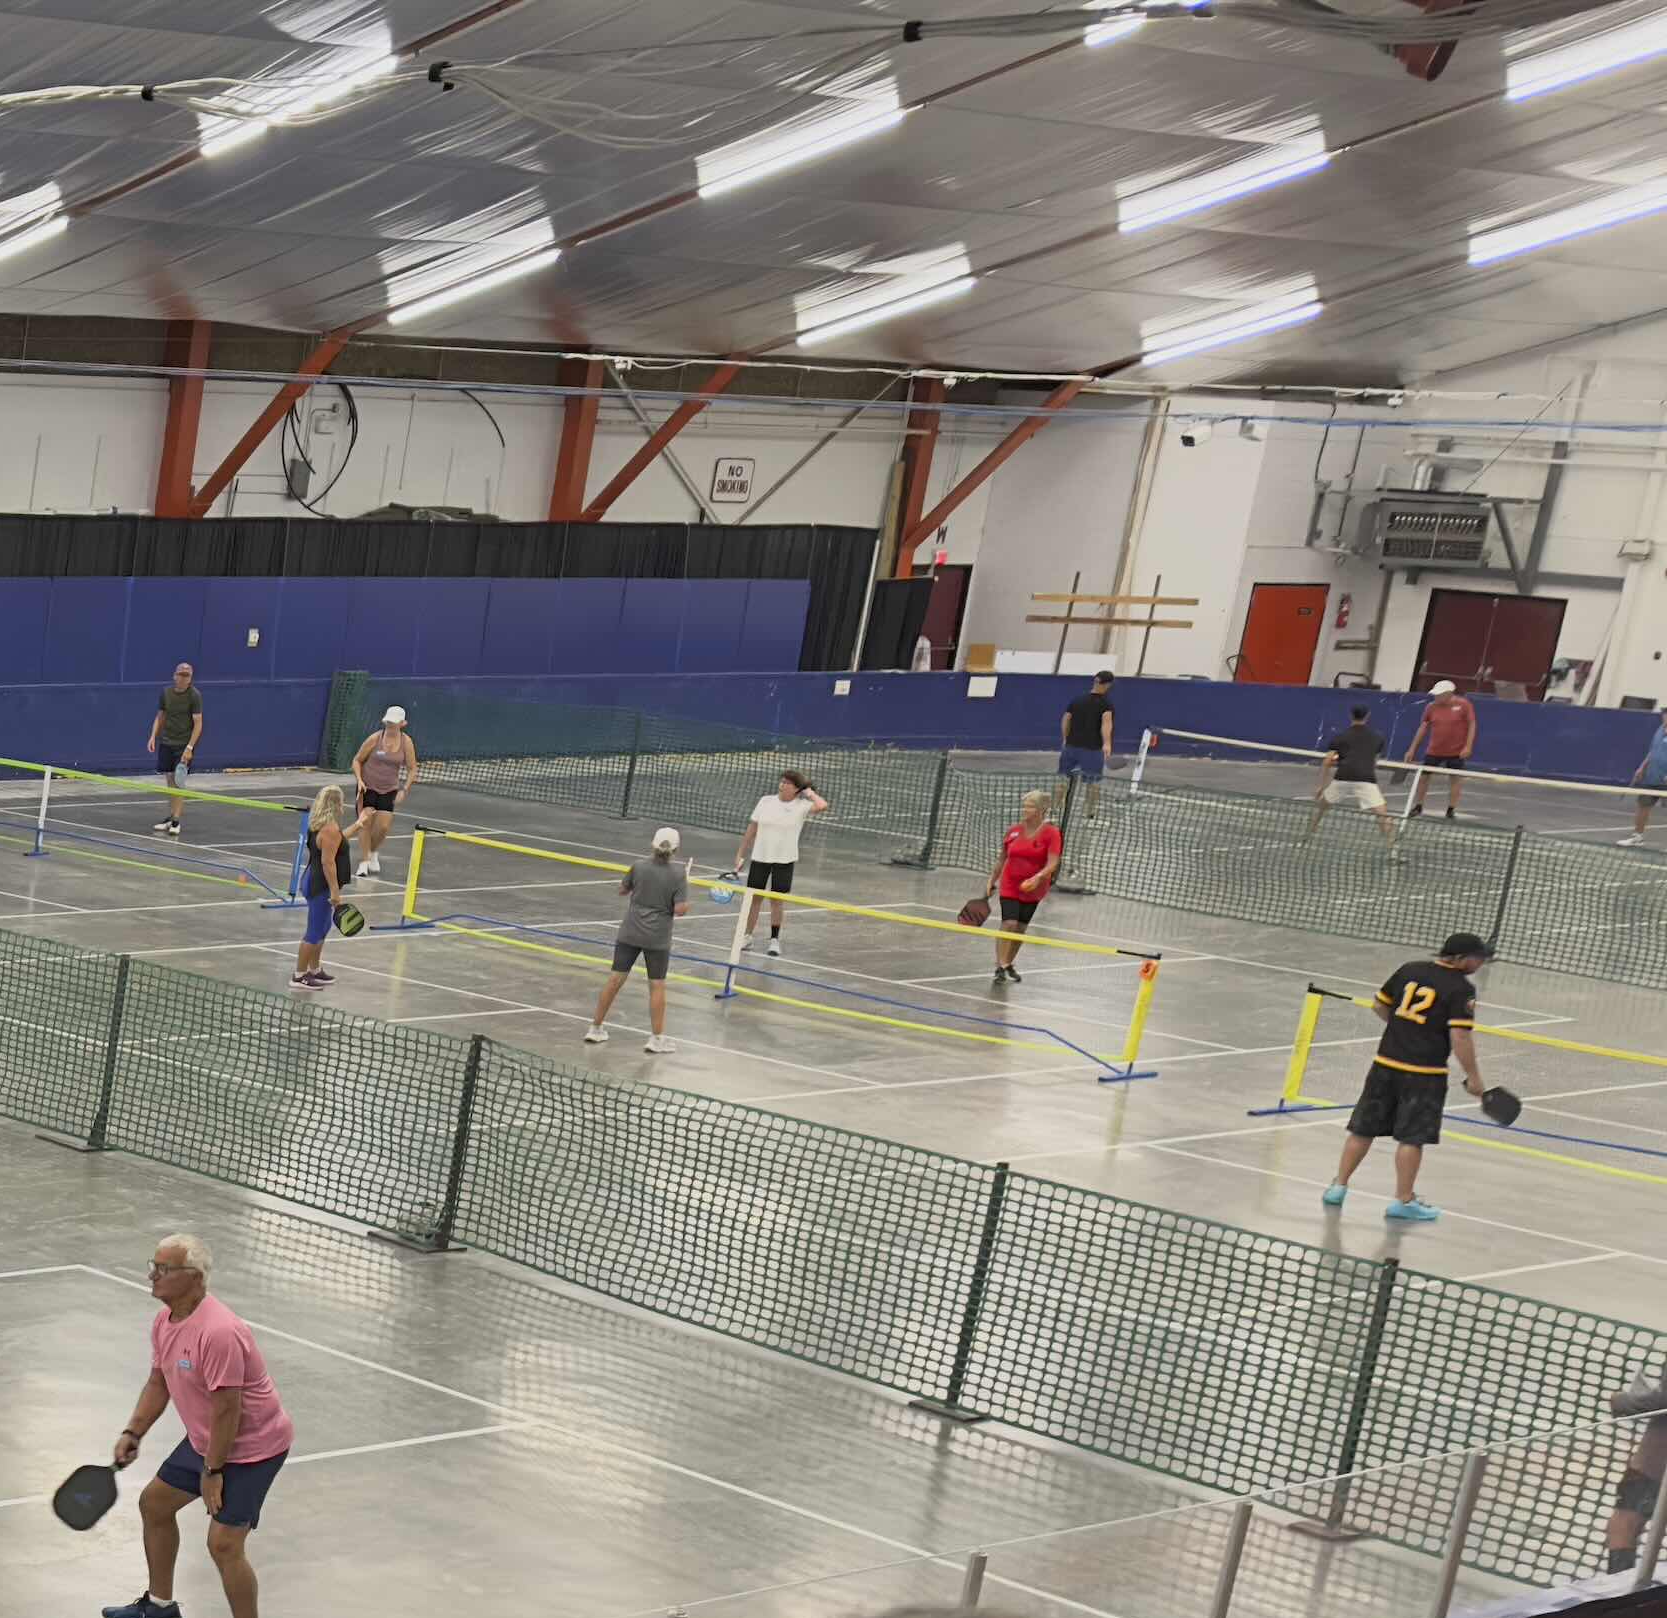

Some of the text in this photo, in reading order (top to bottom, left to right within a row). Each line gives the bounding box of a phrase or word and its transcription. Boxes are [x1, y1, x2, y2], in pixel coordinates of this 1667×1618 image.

[728, 465, 744, 477] NO
[716, 480, 748, 494] SMOKING
[1395, 981, 1436, 1025] 12
